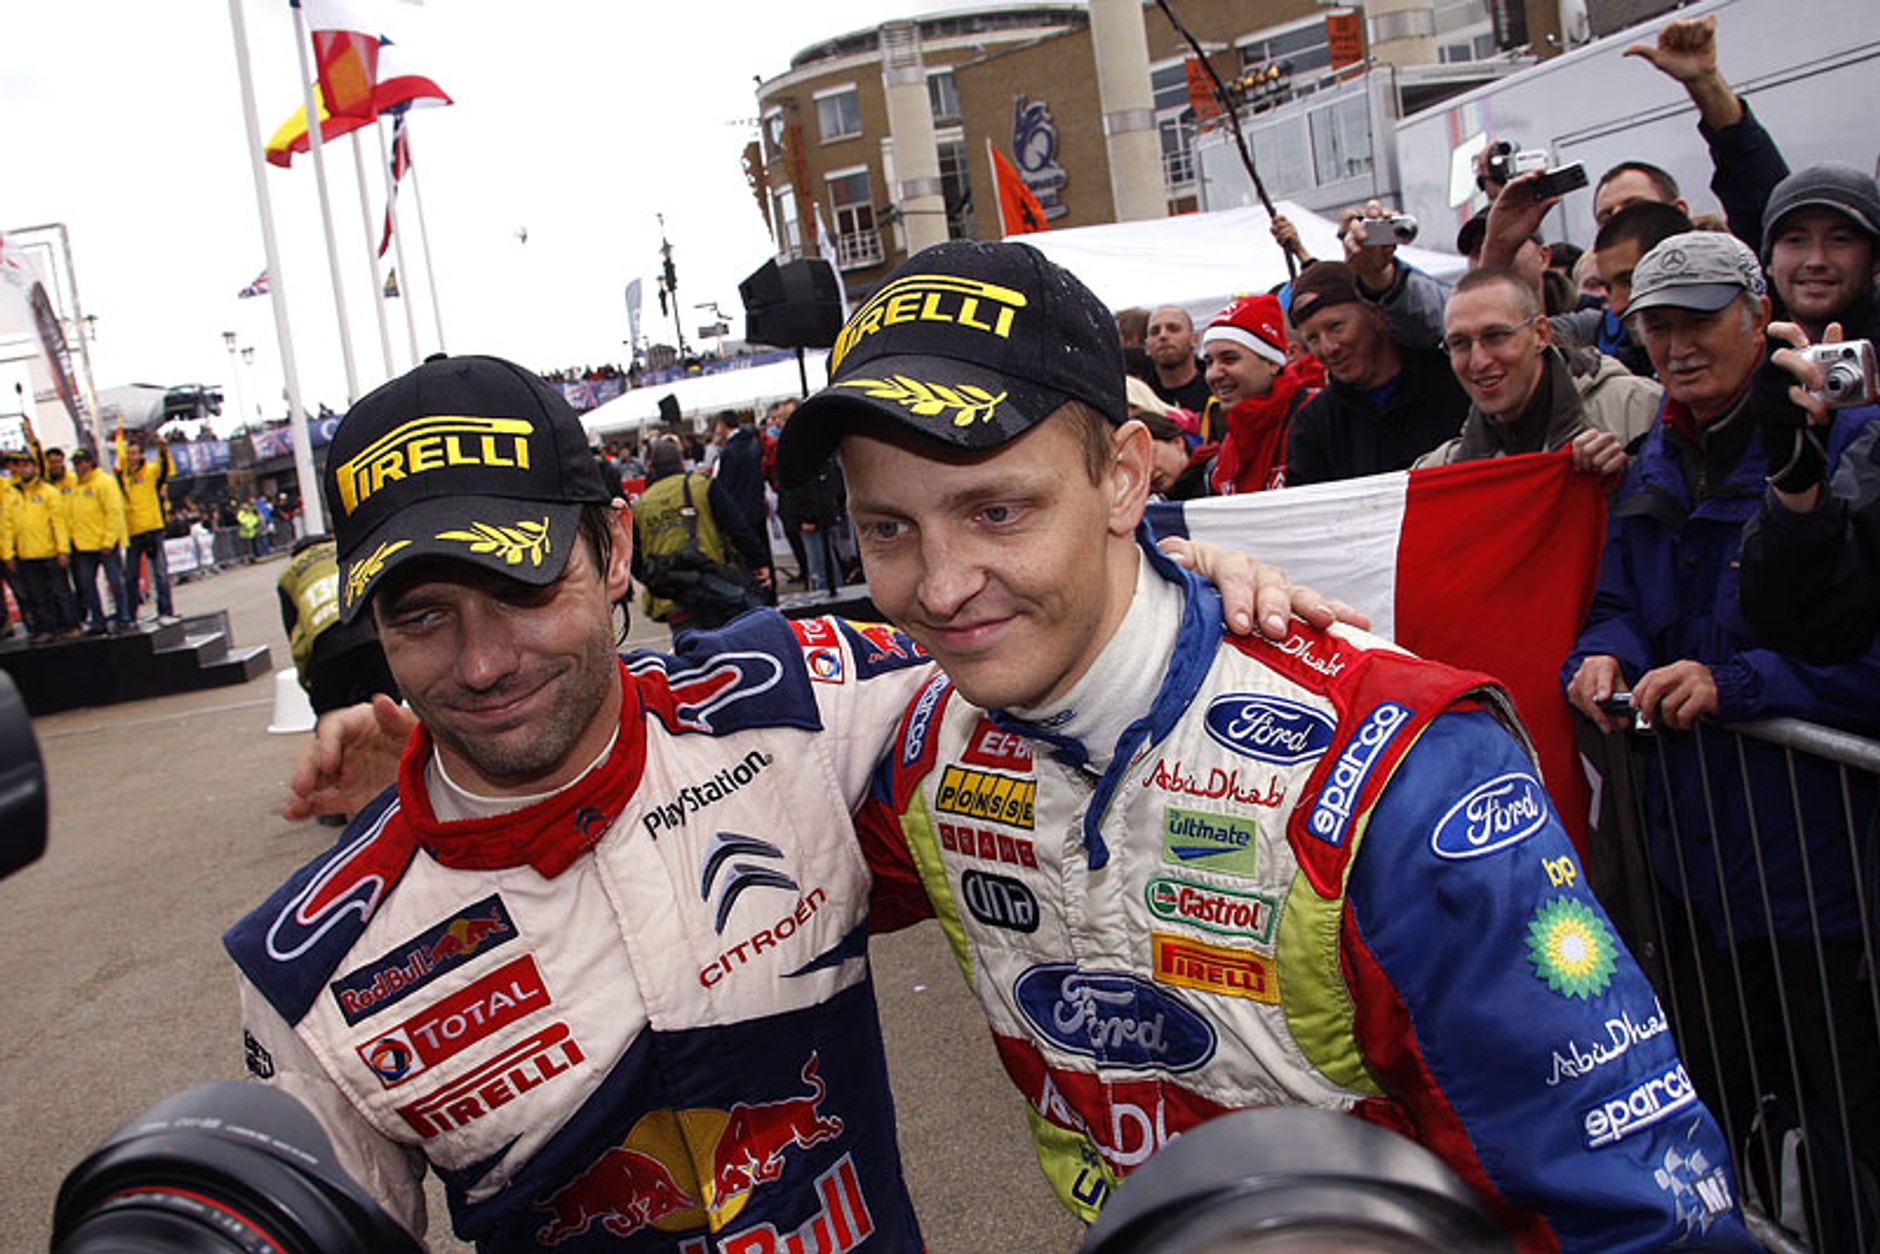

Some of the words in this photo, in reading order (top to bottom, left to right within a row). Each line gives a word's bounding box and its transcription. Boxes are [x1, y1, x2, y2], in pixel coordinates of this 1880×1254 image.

[832, 274, 1028, 378] PIRELLI
[336, 415, 535, 518] PIRELLI
[1228, 702, 1315, 752] Ford
[642, 750, 768, 841] PlayStation
[1142, 759, 1205, 796] Abu
[1203, 768, 1287, 807] Dhabi
[1312, 703, 1408, 842] sparco
[941, 786, 1035, 819] PONSSE
[1466, 782, 1539, 846] Ford
[1170, 817, 1251, 846] ultimate
[1542, 855, 1577, 888] bp
[1179, 887, 1260, 931] Castrol
[1161, 942, 1267, 994] PIRELLI
[340, 974, 390, 1015] Red
[413, 981, 540, 1050] TOTAL
[1053, 973, 1169, 1052] Ford
[394, 1021, 585, 1139] PIRELLI
[1546, 1041, 1608, 1087] Abu
